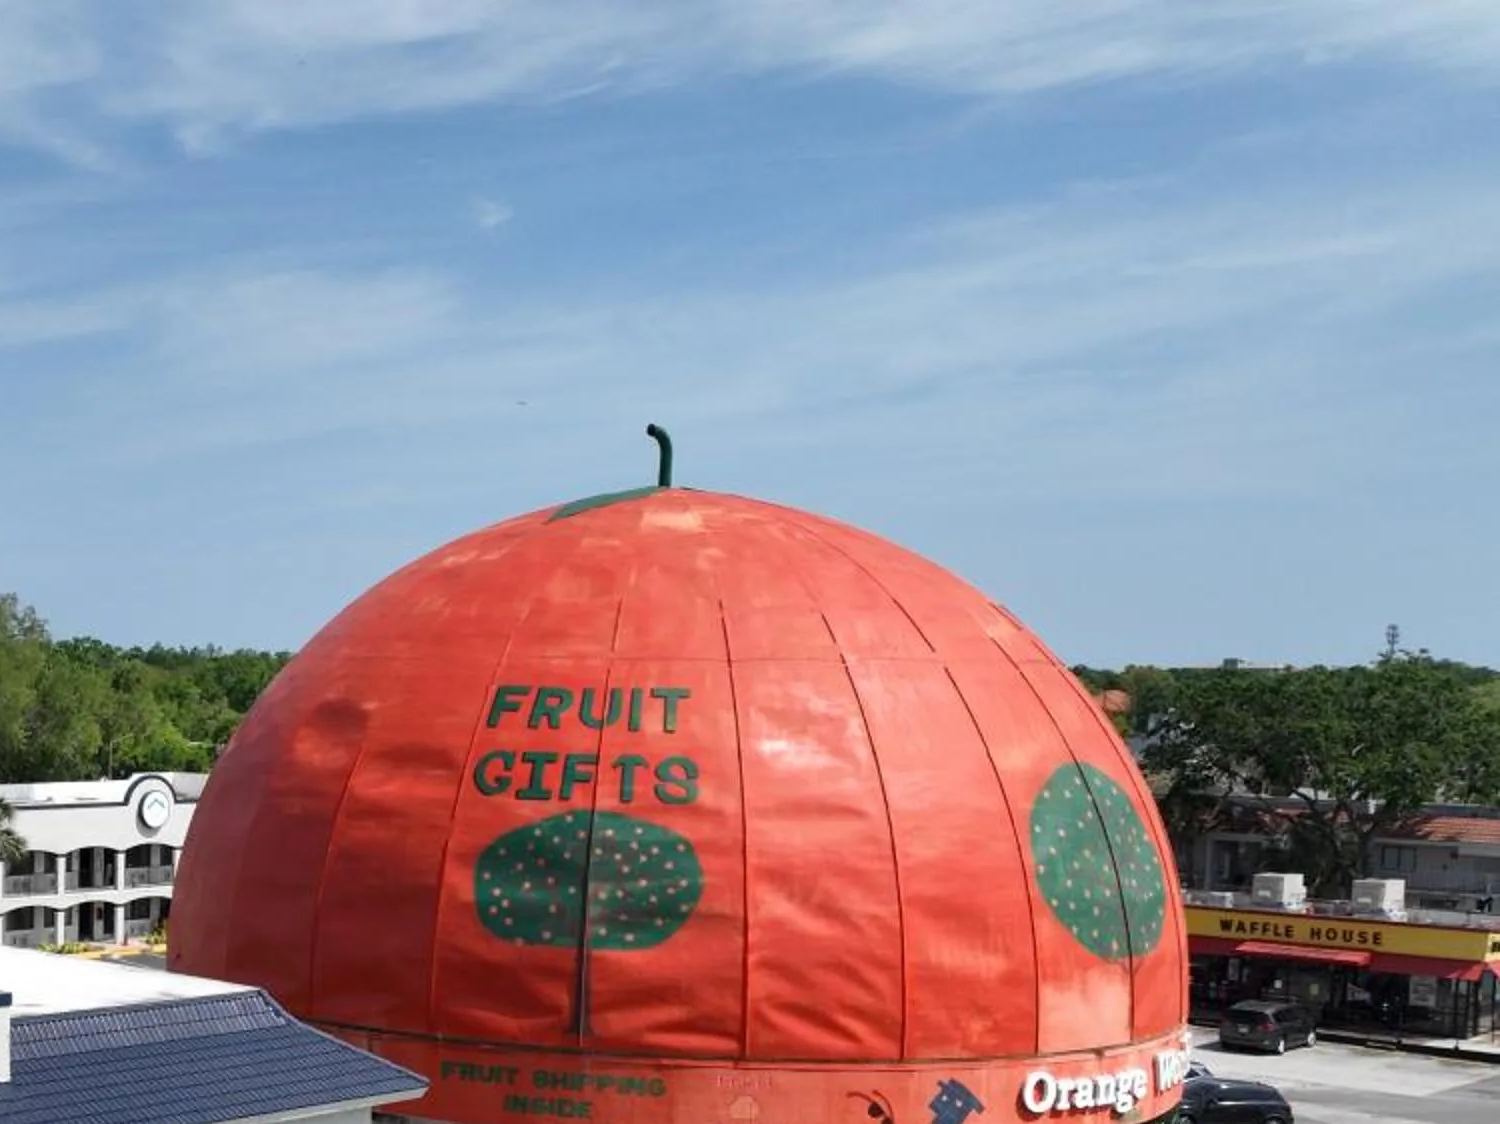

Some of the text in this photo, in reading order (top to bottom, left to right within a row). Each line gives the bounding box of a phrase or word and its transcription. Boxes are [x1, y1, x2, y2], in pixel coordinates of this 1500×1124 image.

[486, 685, 692, 733] FRUIT
[473, 751, 699, 805] GIFTS
[1219, 918, 1383, 946] WAFFLE HOUSE
[440, 1060, 667, 1097] FRUIT SHIPPING
[1023, 1068, 1148, 1114] Orange
[503, 1093, 593, 1119] INSIDE
